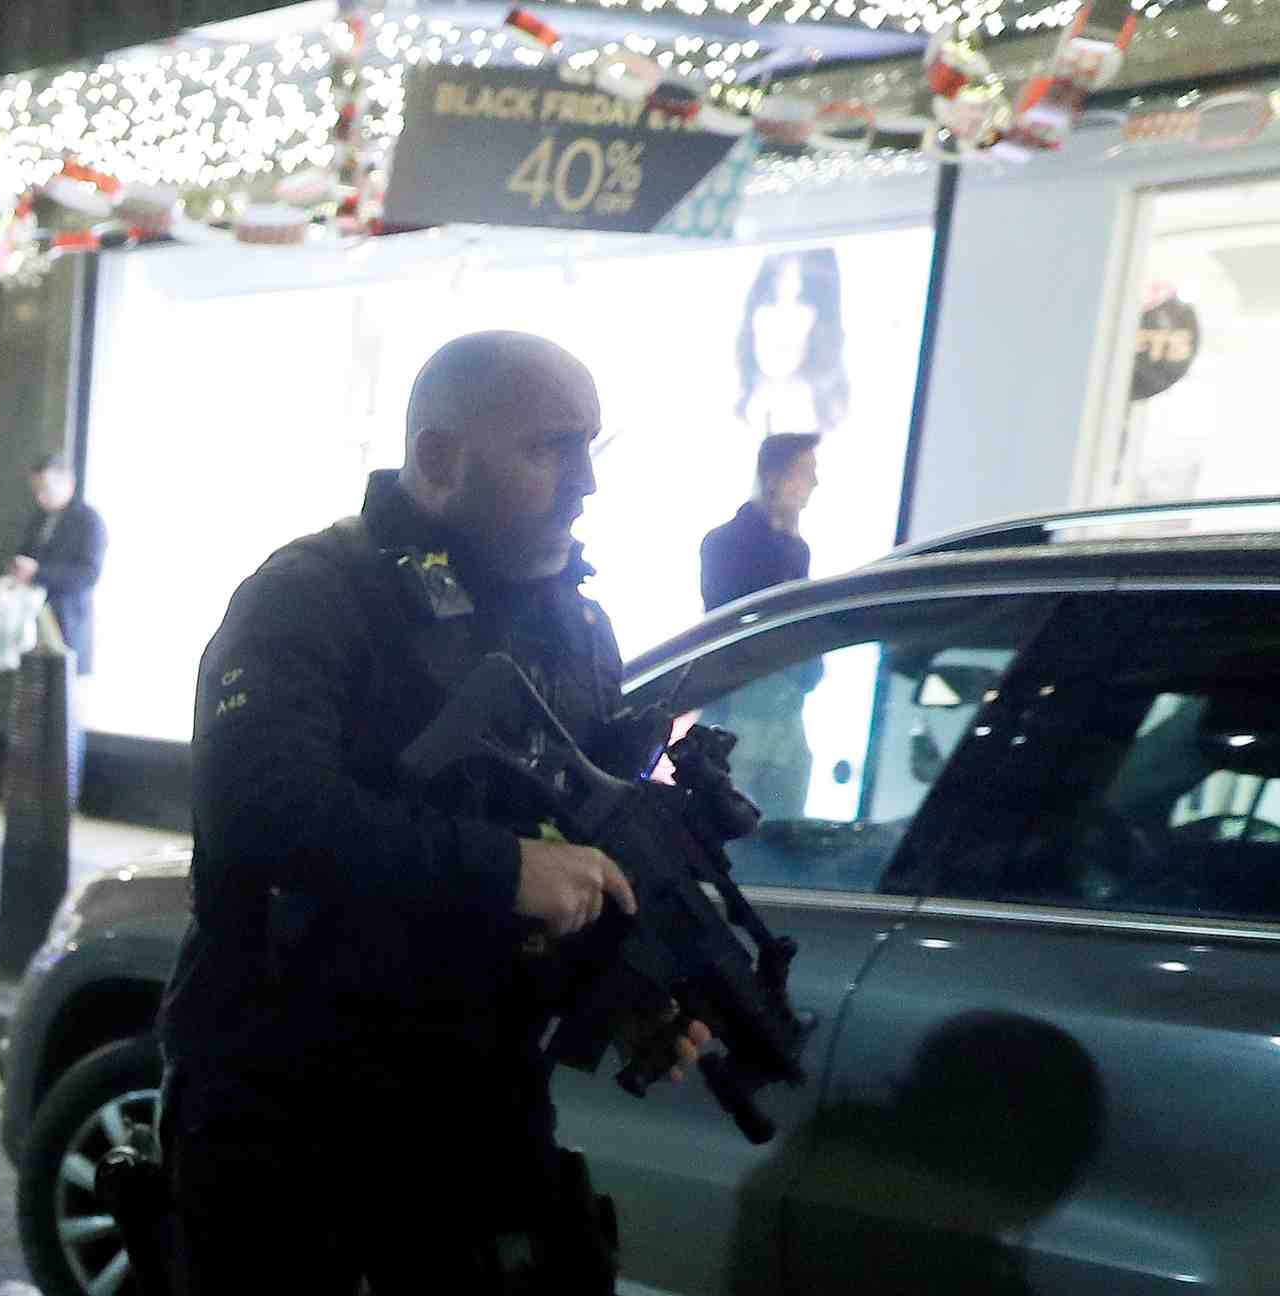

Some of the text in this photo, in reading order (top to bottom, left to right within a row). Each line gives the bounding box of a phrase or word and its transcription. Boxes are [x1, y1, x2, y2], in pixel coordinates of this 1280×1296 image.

[434, 82, 538, 117] BLACK
[540, 88, 642, 127] FRIDAY
[506, 134, 645, 213] 40%
